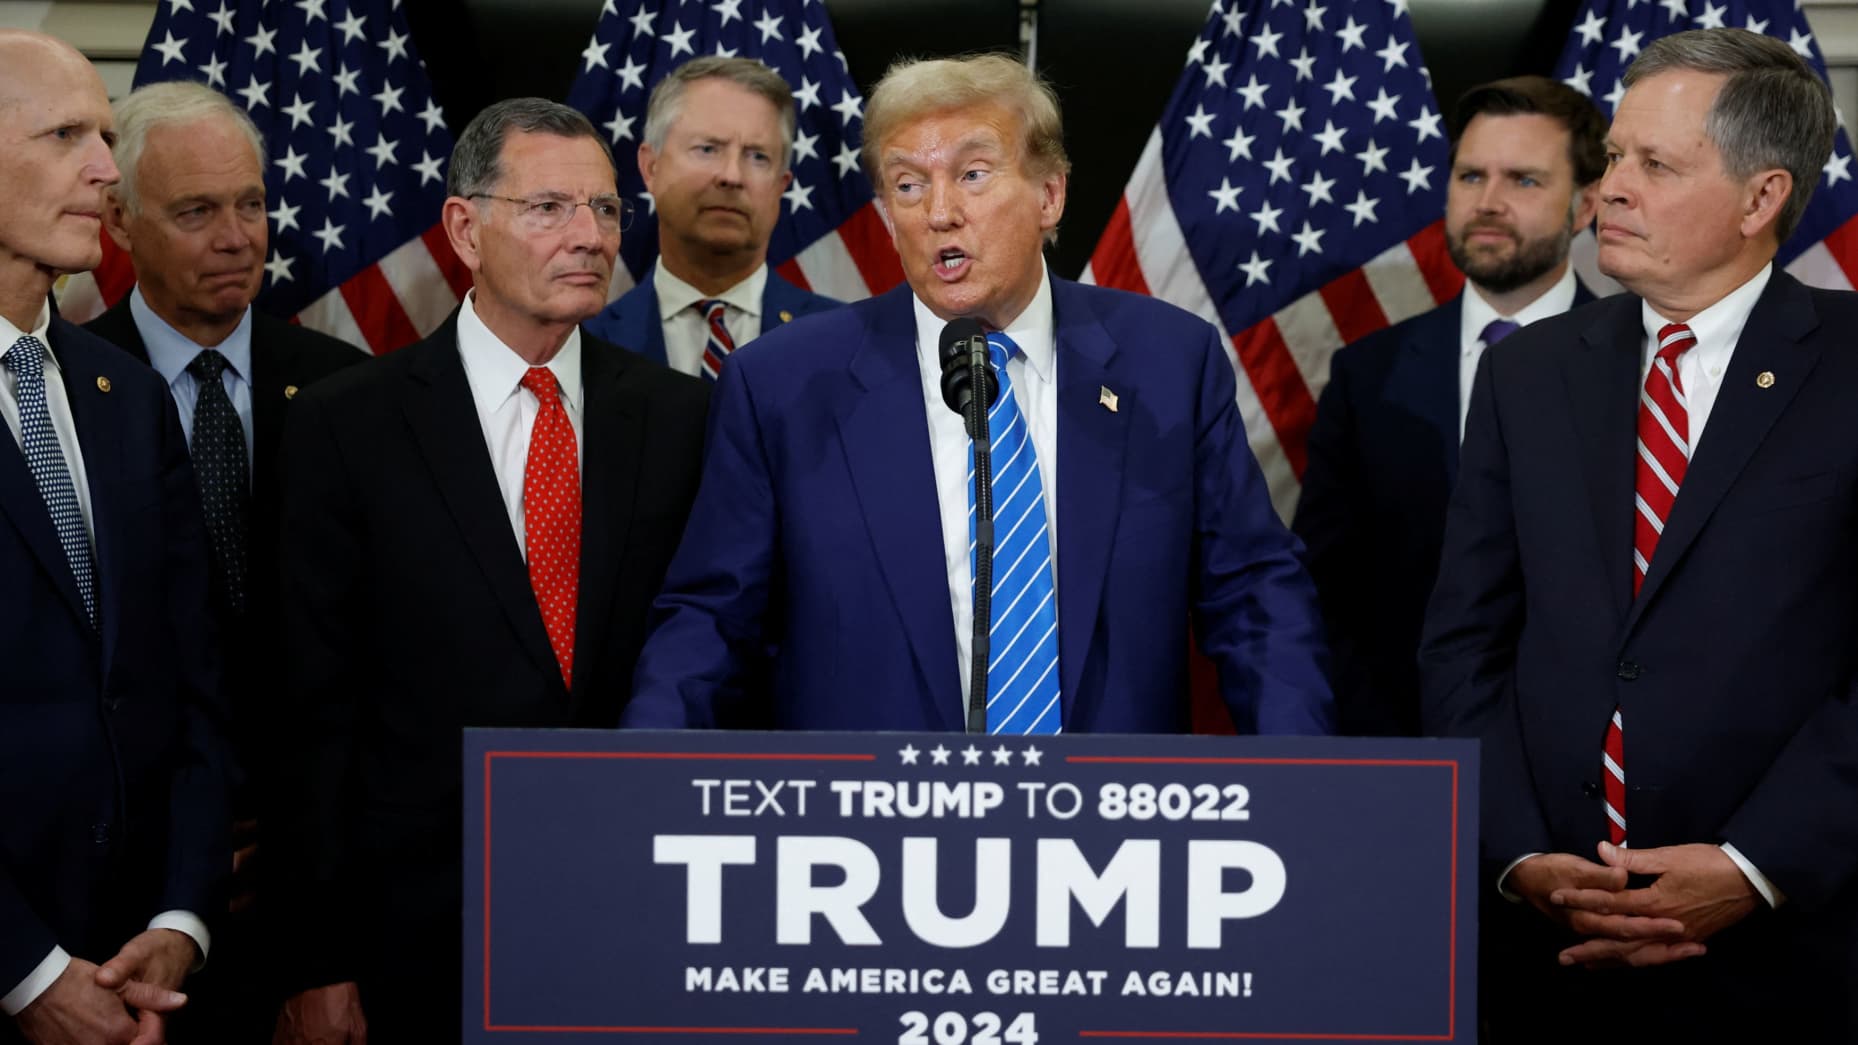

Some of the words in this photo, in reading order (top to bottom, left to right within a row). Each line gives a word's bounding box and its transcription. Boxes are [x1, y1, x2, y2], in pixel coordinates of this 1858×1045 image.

[691, 779, 816, 817] TEXT
[830, 780, 1004, 819] TRUMP
[1017, 782, 1083, 820] TO
[1097, 782, 1250, 821] 88022
[653, 834, 1287, 950] TRUMP
[685, 966, 789, 993] MAKE
[802, 967, 973, 995] AMERICA
[986, 969, 1108, 996] GREAT
[1121, 970, 1253, 997] AGAIN!
[898, 1010, 1039, 1045] 2024
